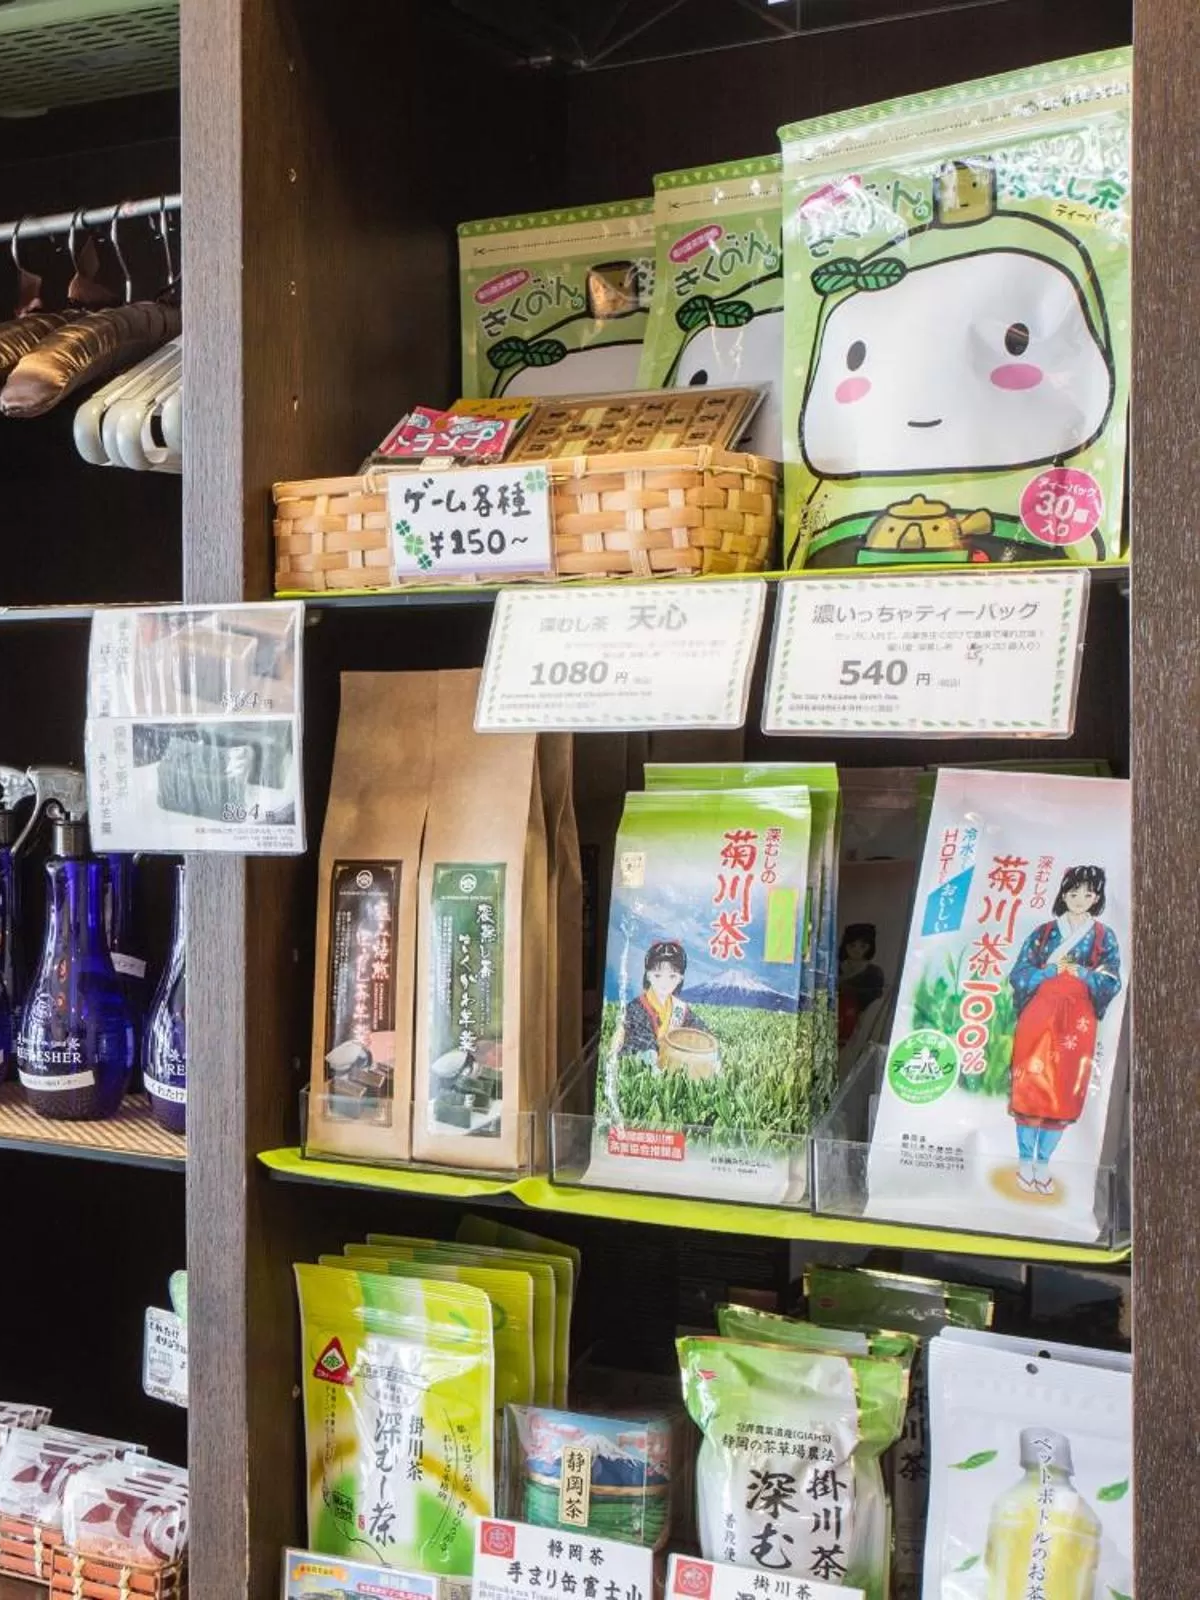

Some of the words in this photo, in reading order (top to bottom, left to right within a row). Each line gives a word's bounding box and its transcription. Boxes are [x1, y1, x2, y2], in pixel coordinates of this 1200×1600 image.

[404, 478, 532, 518] ゲーム各種
[628, 603, 688, 631] 天心
[530, 660, 609, 686] 1080
[839, 659, 908, 686] 540
[916, 672, 931, 686] 円
[223, 803, 260, 822] 864
[761, 828, 782, 884] 深むしの
[708, 829, 758, 960] 菊川茶
[1030, 855, 1055, 909] 深むしの
[406, 1415, 425, 1482] 掛川茶
[369, 1409, 403, 1546] 深むし茶
[565, 1451, 585, 1519] 静岡茶
[806, 1468, 849, 1581] 掛川茶
[547, 1538, 605, 1567] 静岡茶
[507, 1561, 643, 1600] 手まり缶富士山
[753, 1573, 813, 1600] 掛川茶
